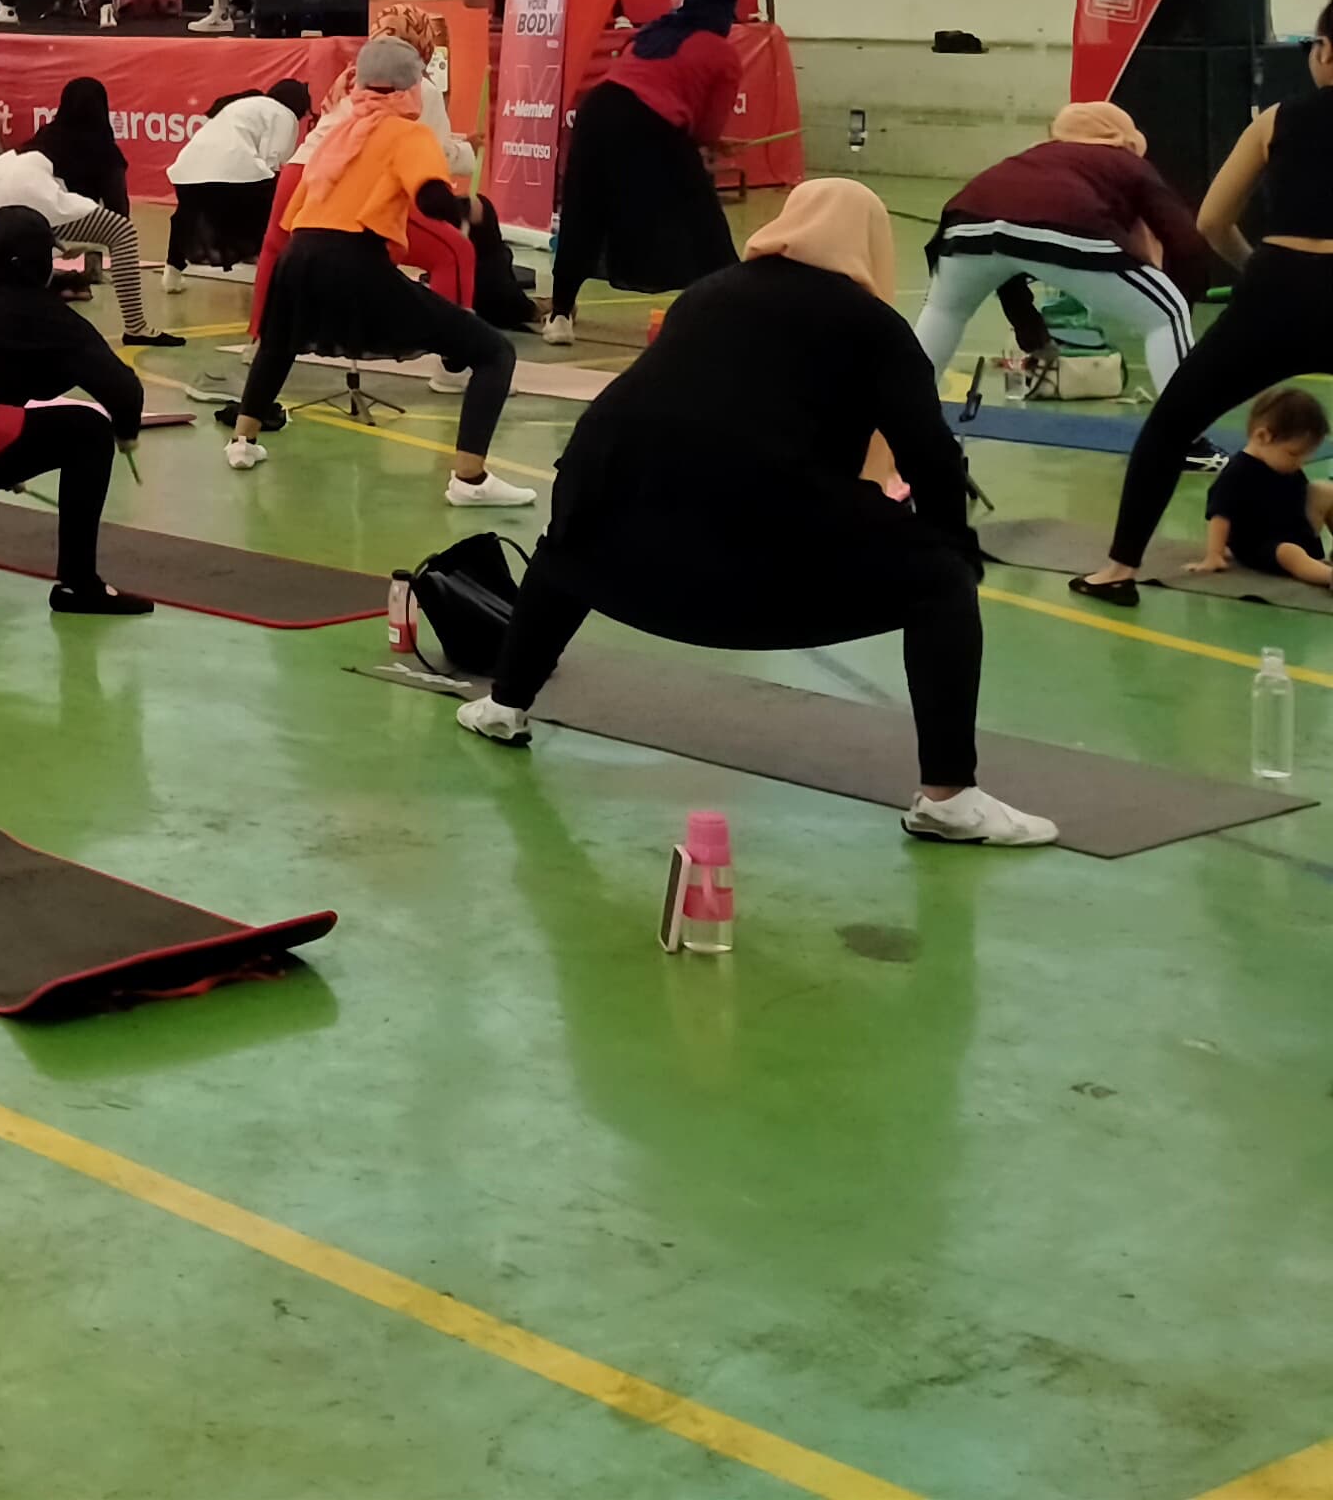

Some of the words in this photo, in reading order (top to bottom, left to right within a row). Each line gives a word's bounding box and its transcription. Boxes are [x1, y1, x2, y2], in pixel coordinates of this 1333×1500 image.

[527, 0, 548, 10] YOUR
[516, 13, 558, 34] BODY
[32, 106, 210, 143] muras
